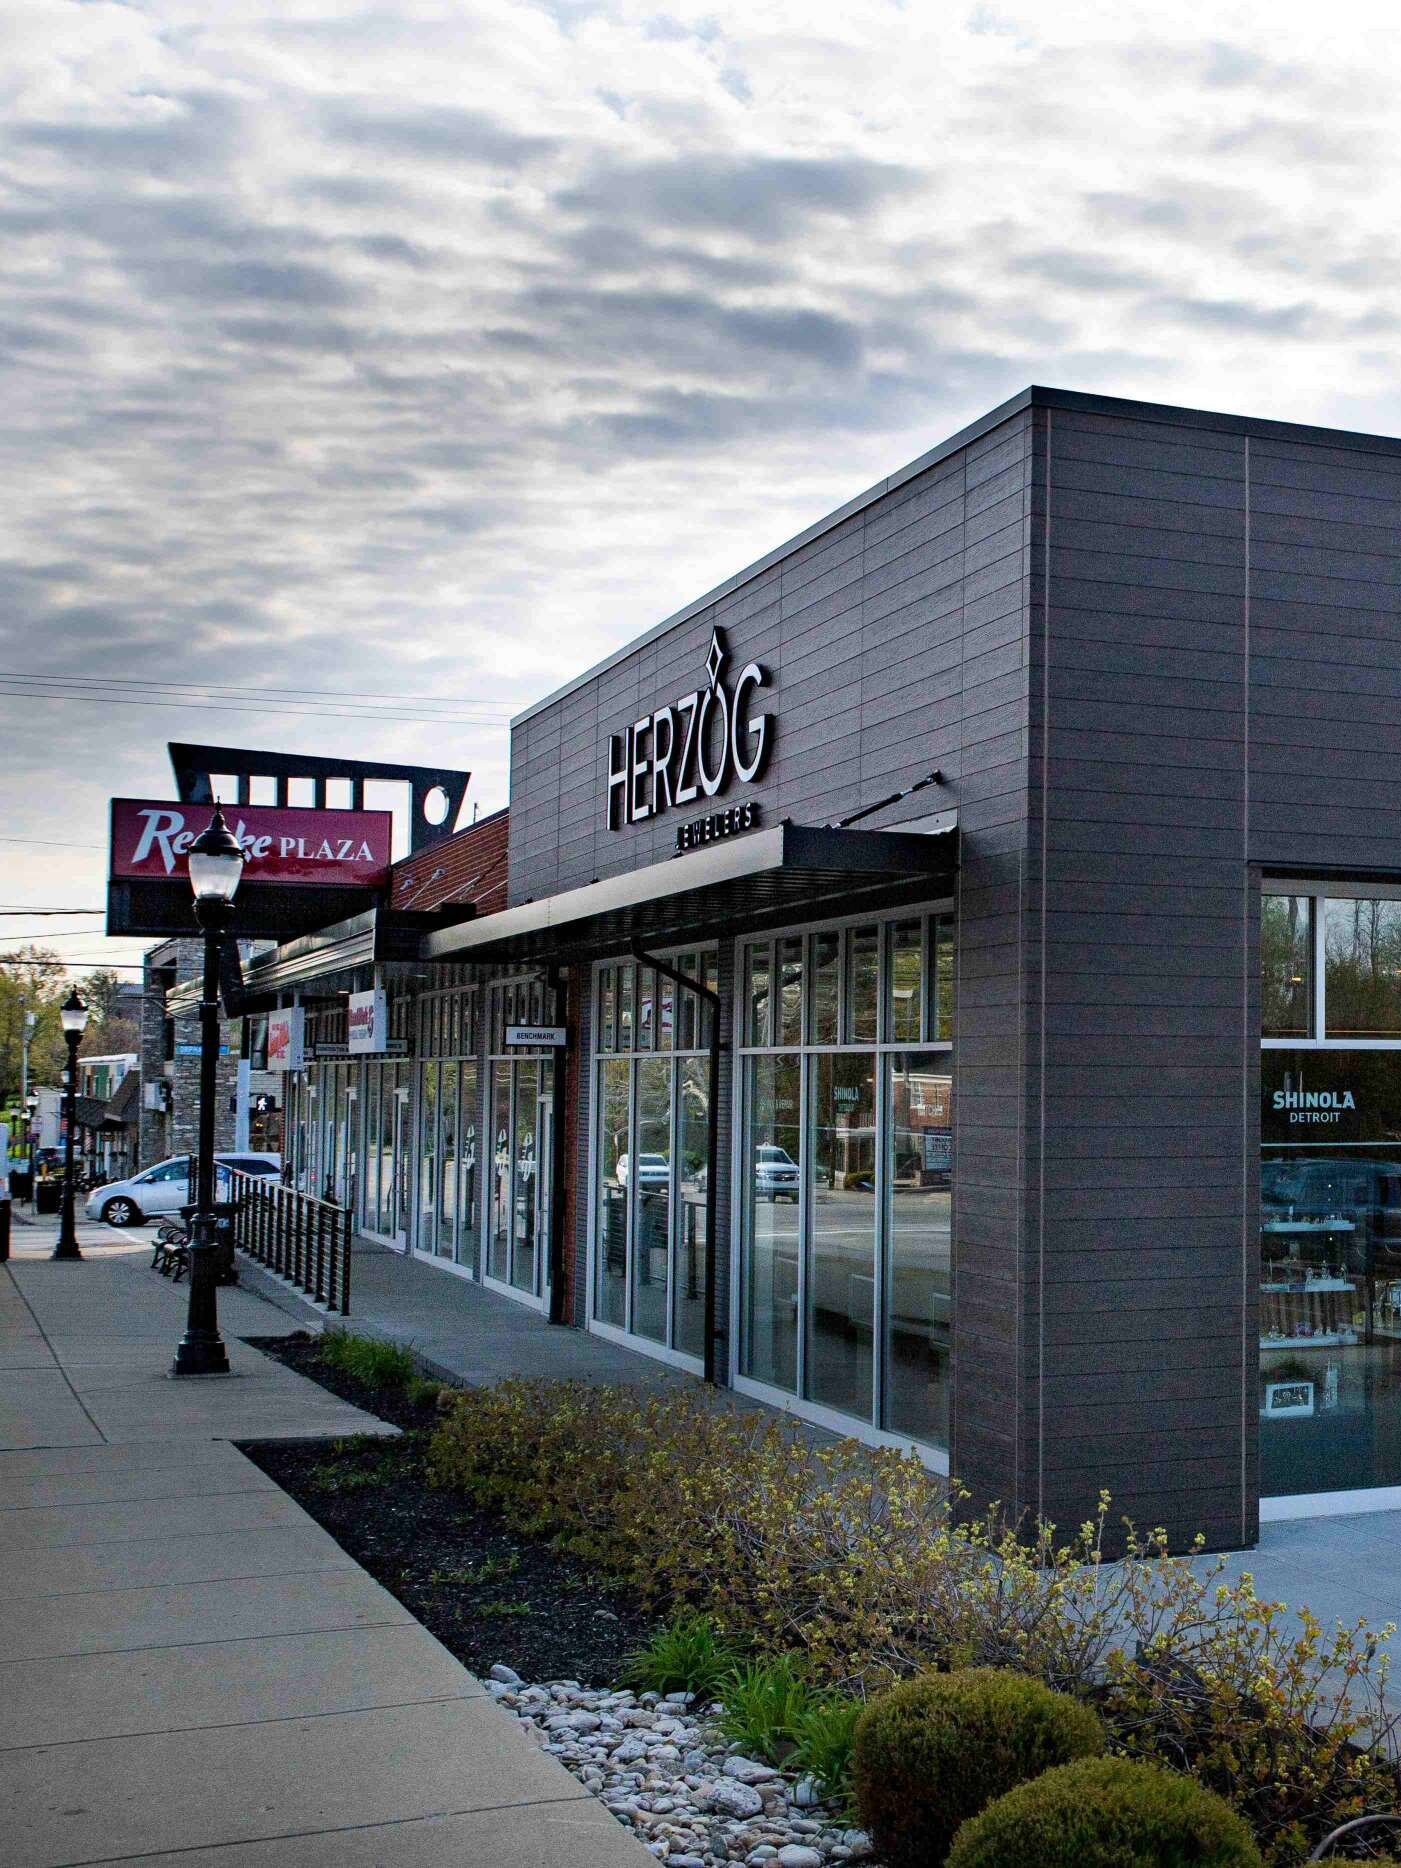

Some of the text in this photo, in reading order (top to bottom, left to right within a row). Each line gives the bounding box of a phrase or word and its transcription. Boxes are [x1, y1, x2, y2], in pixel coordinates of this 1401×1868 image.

[606, 628, 770, 831] HERZOG
[131, 809, 375, 874] Reke PLAZA
[516, 1032, 556, 1040] BENCHMARK
[833, 1086, 860, 1102] SHINOLA
[1273, 1090, 1355, 1110] SHINOLA
[1289, 1112, 1341, 1123] DETROIT
